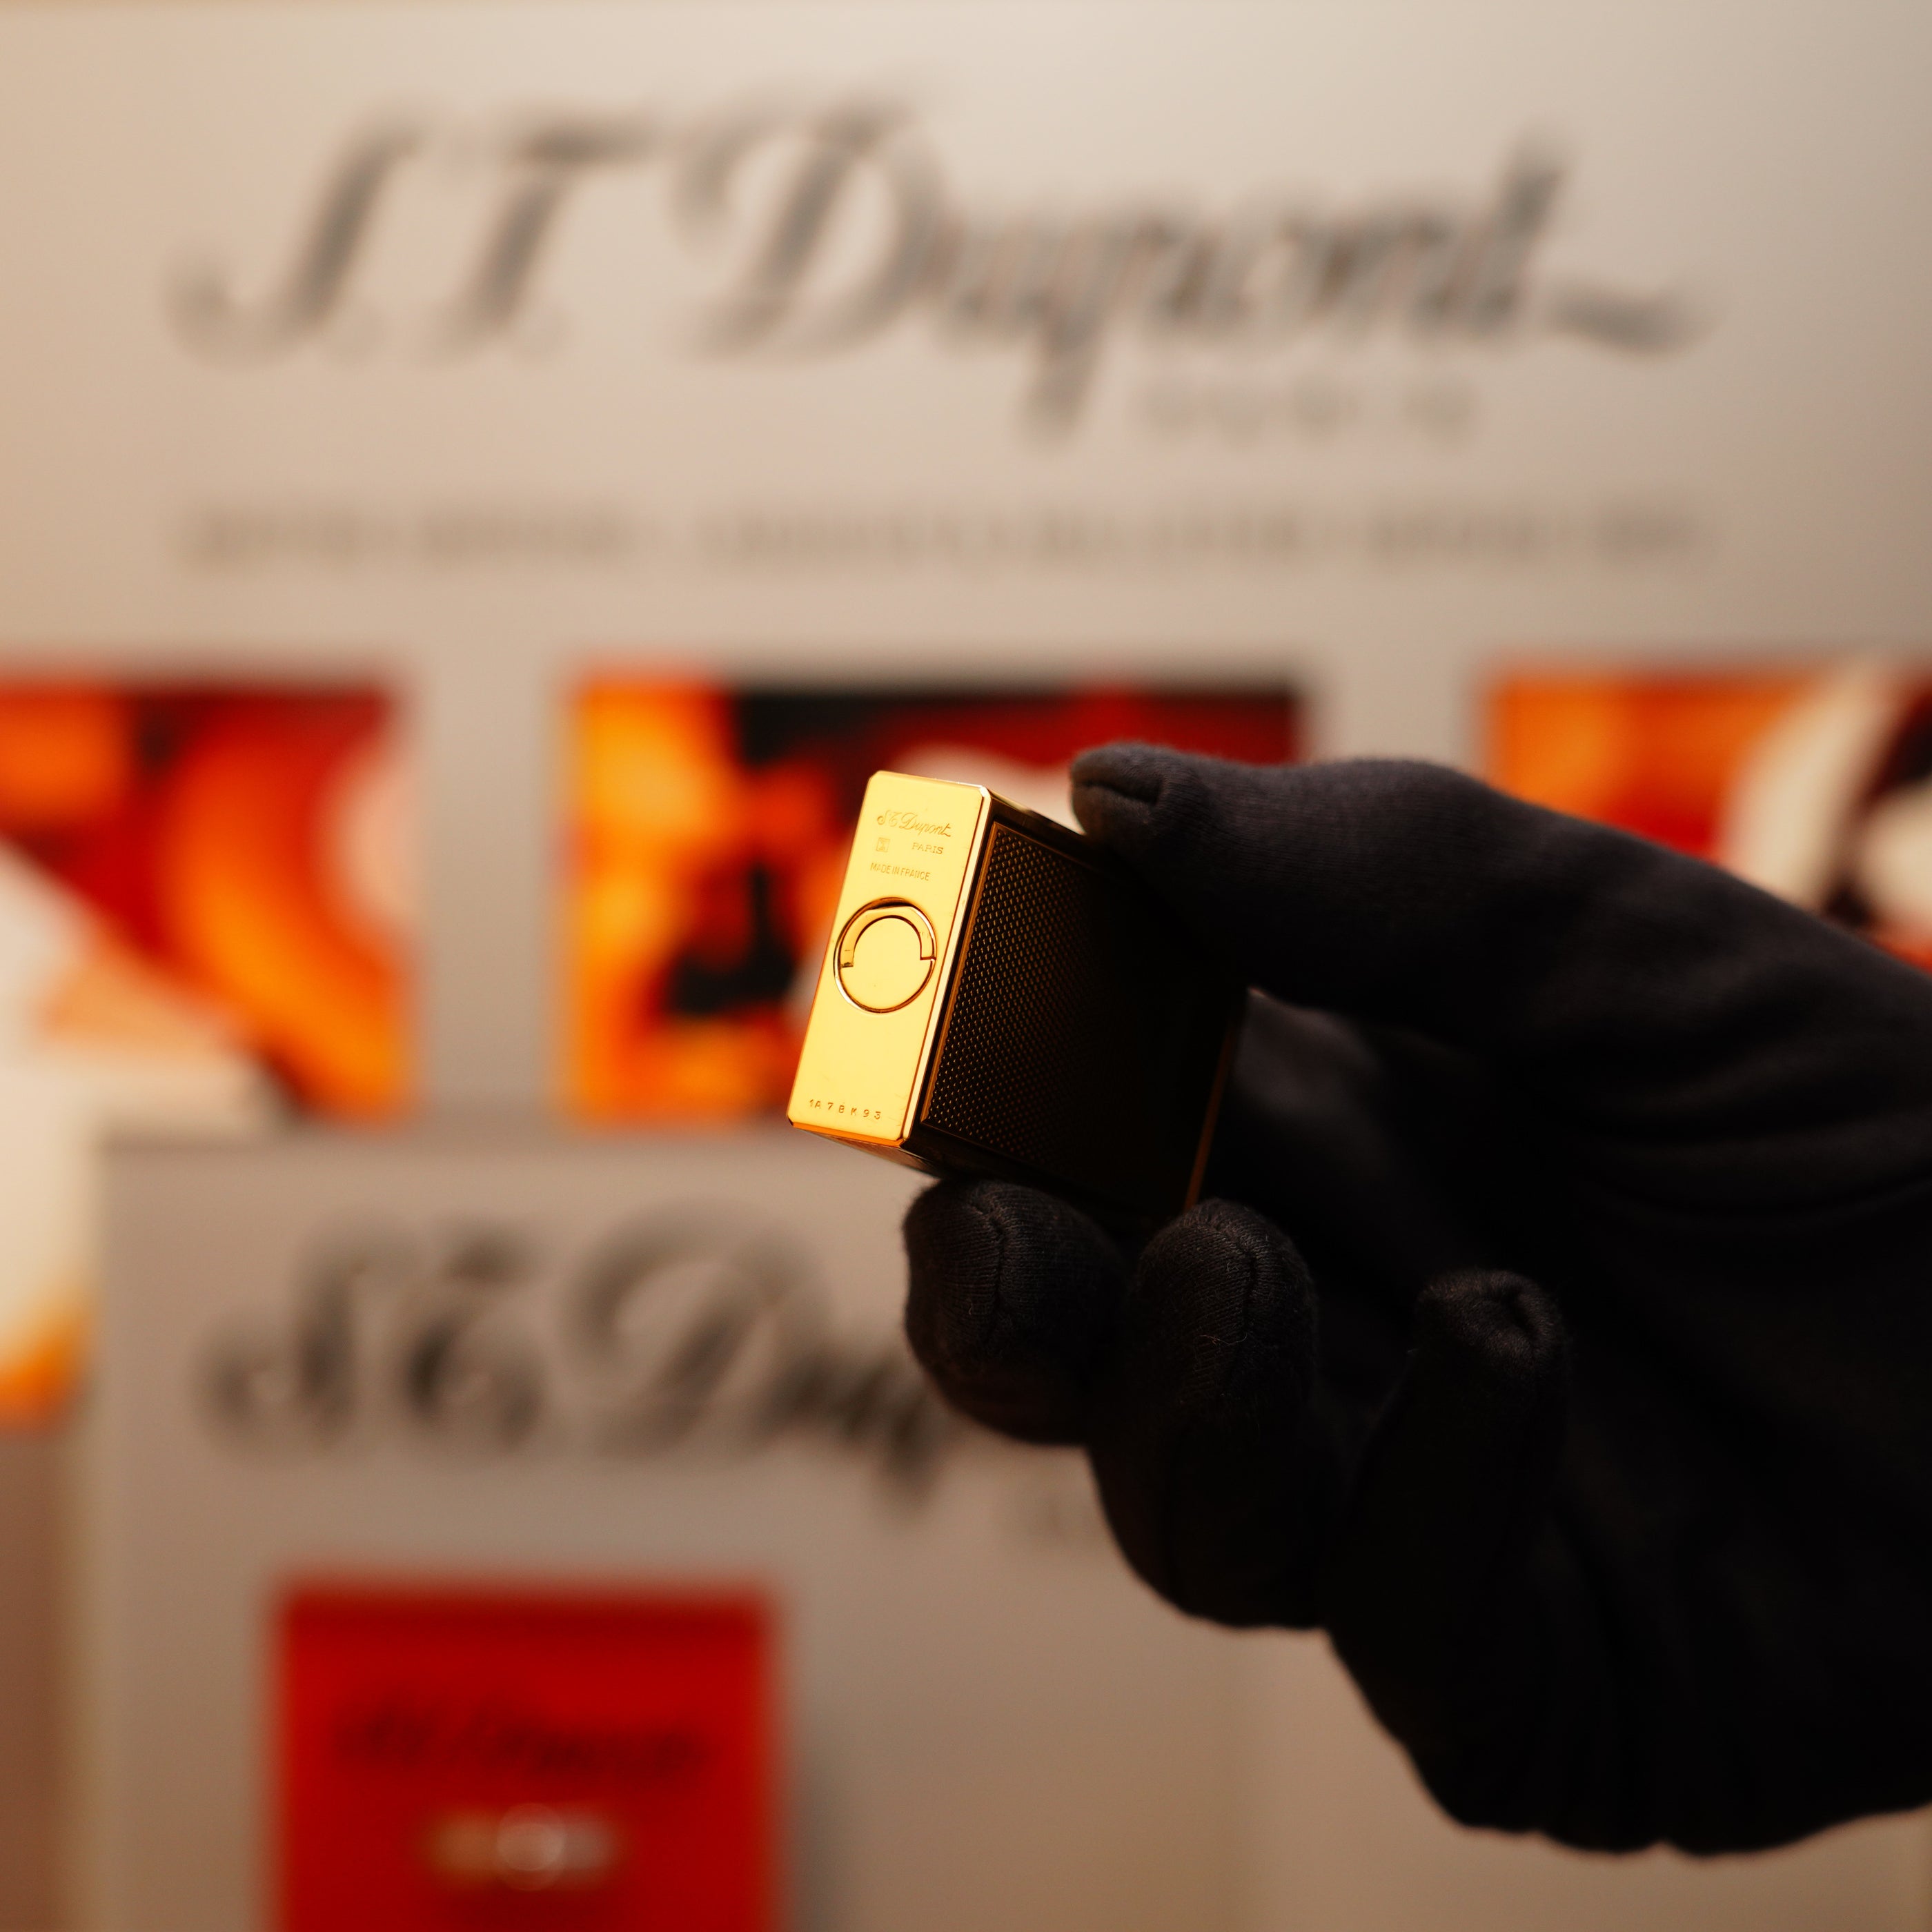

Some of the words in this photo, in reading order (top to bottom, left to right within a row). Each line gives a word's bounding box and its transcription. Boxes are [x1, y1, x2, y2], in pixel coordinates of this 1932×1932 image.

[678, 101, 1707, 433] Dupont
[898, 812, 951, 837] Dupont
[911, 842, 944, 854] PARIS
[870, 862, 890, 874] MADE
[892, 866, 899, 875] IN
[900, 868, 931, 881] FRANCE
